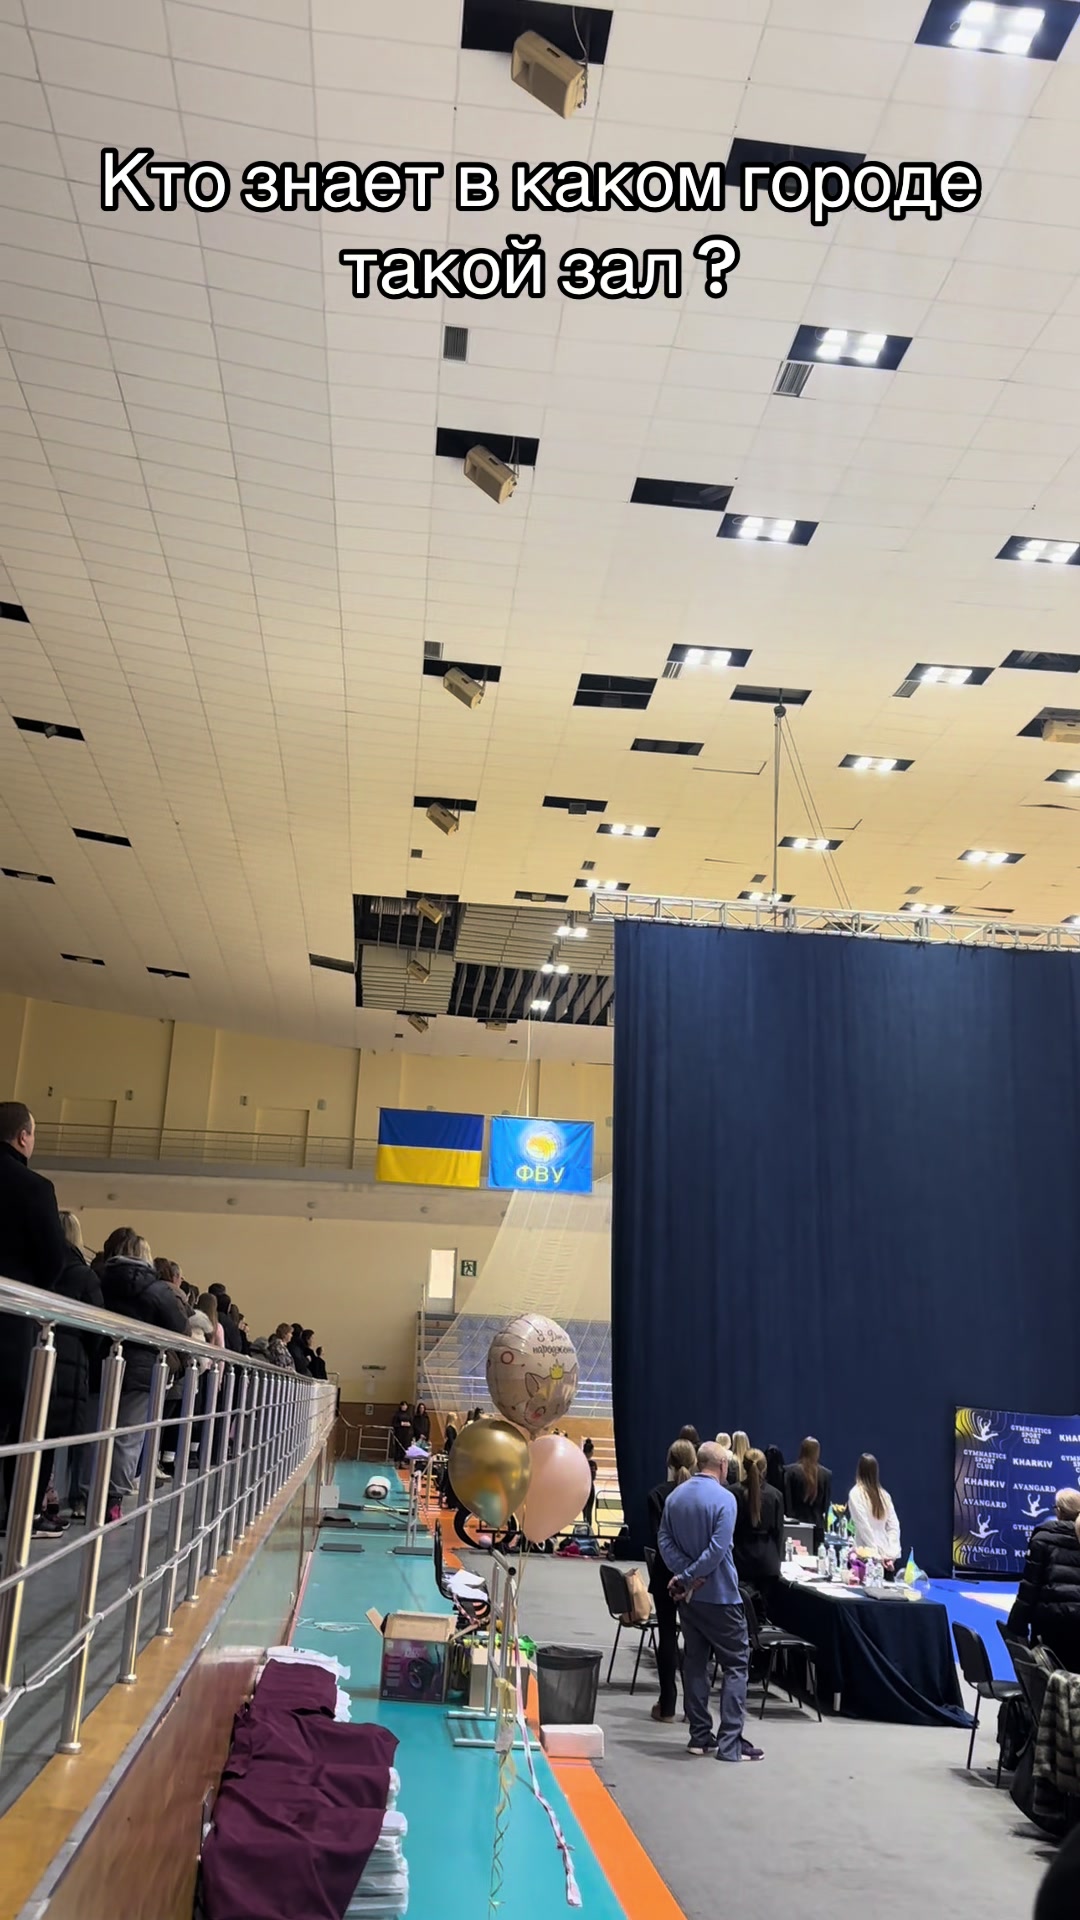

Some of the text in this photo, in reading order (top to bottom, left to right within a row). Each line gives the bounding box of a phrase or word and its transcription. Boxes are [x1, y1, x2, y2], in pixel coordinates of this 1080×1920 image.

[516, 1165, 565, 1183] ФВУ
[1010, 1424, 1052, 1435] GYMNASTICS
[1021, 1431, 1041, 1439] SPORT
[1023, 1437, 1040, 1445] CLUB
[963, 1449, 1007, 1460] GYMNASTICS
[974, 1457, 996, 1465] SPORT
[1012, 1457, 1053, 1468] KHARKIV
[964, 1477, 1006, 1489] KHARKIV
[1012, 1483, 1056, 1493] AVANGARD
[963, 1498, 1007, 1509] AVANGARD
[962, 1545, 1008, 1556] AVANGARD
